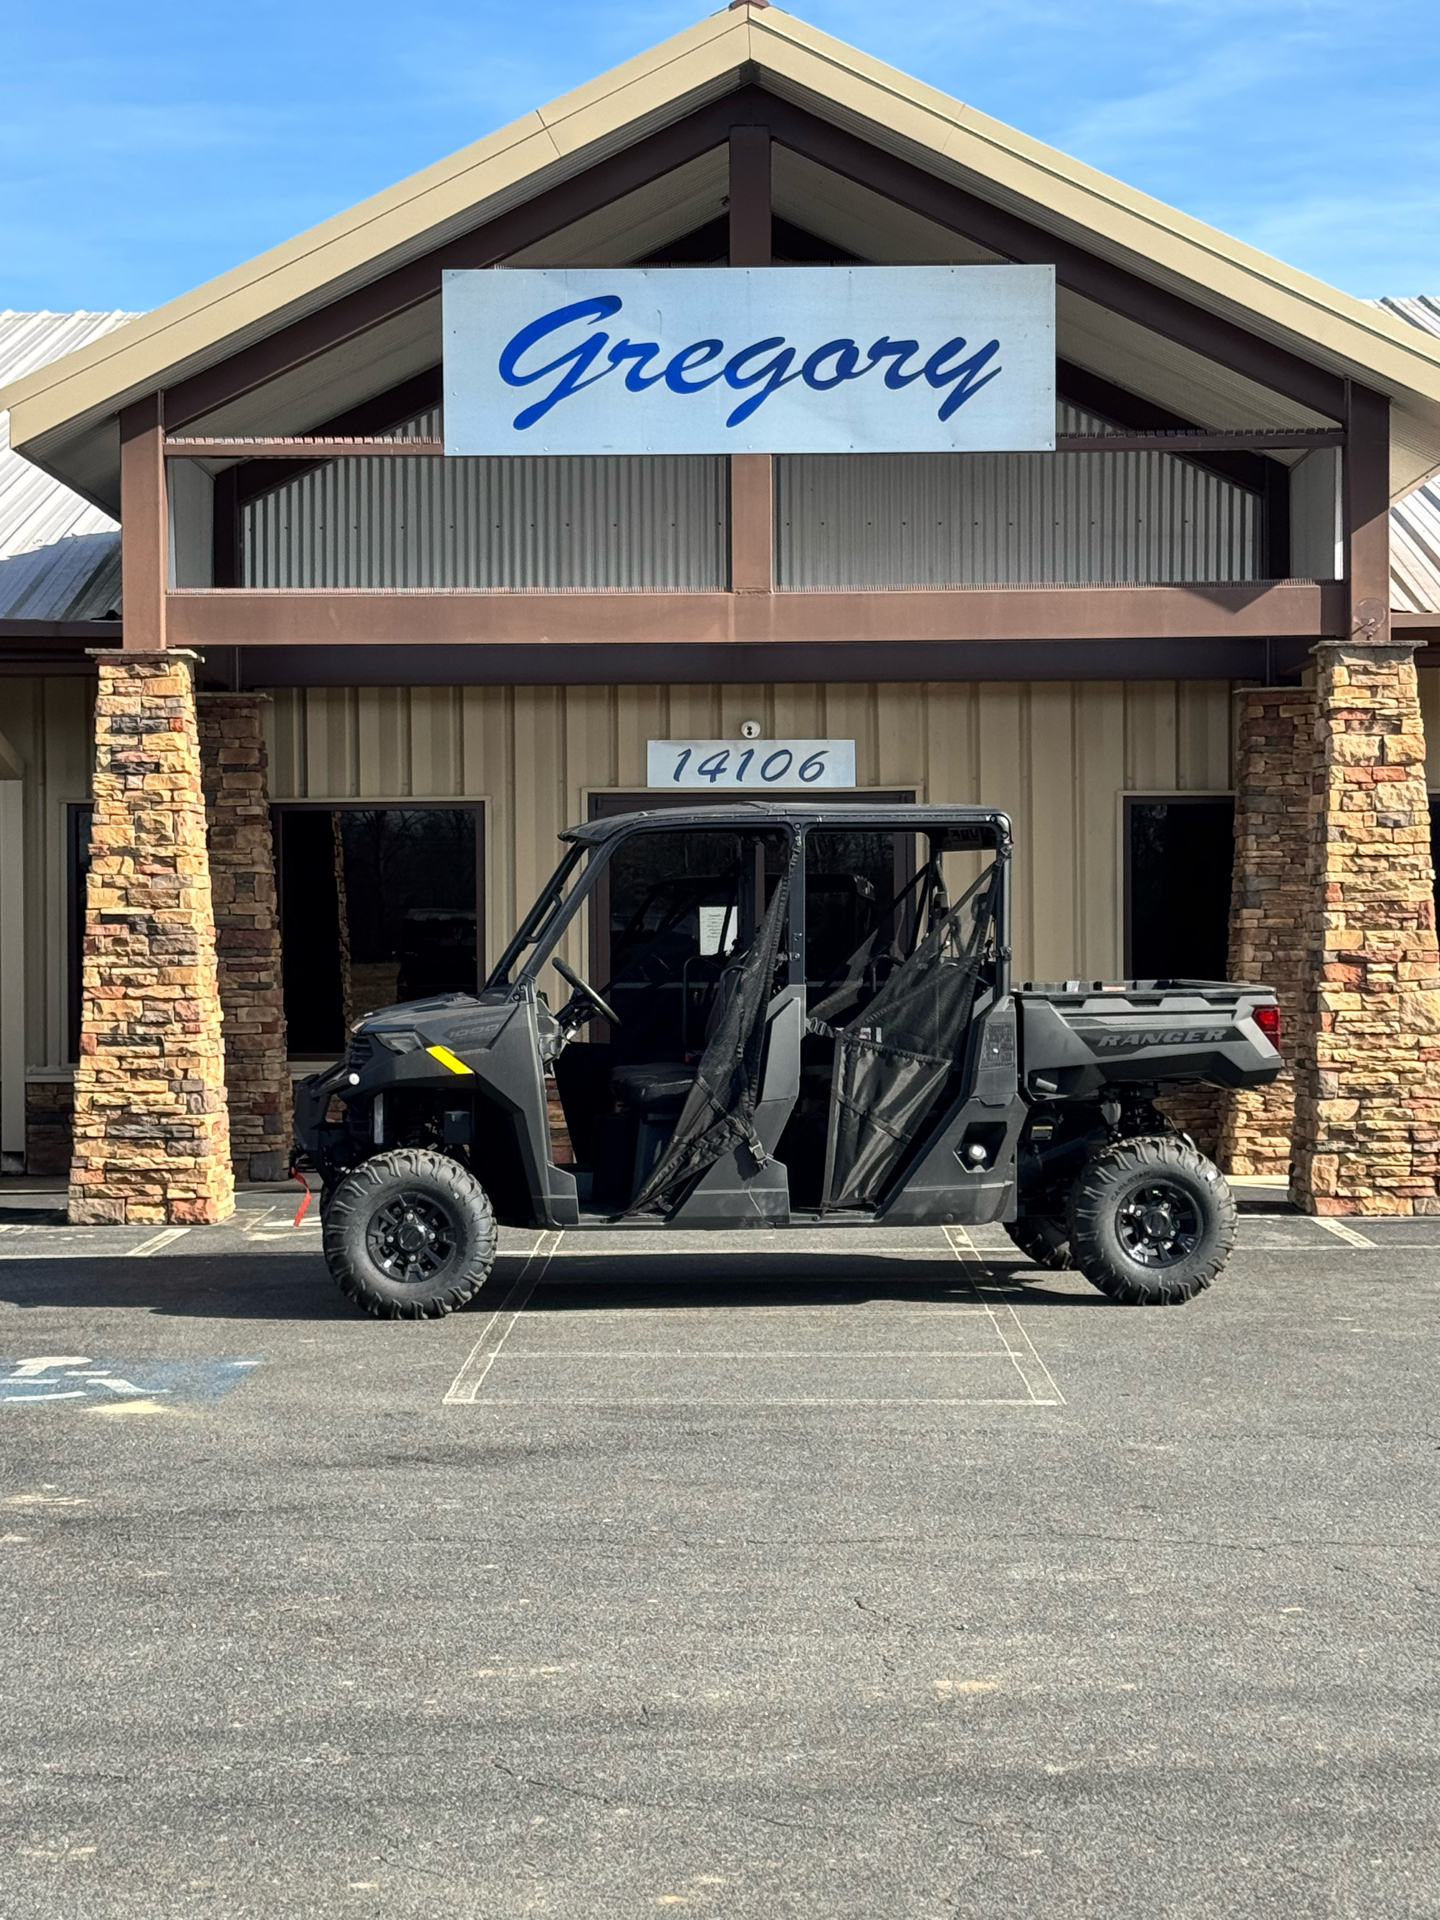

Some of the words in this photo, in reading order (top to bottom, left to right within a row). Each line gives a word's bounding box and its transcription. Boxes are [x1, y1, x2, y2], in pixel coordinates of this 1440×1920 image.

[498, 294, 1002, 431] Gregory
[673, 748, 830, 783] 14106
[450, 1023, 500, 1038] 1000
[1097, 1029, 1227, 1047] RANGER
